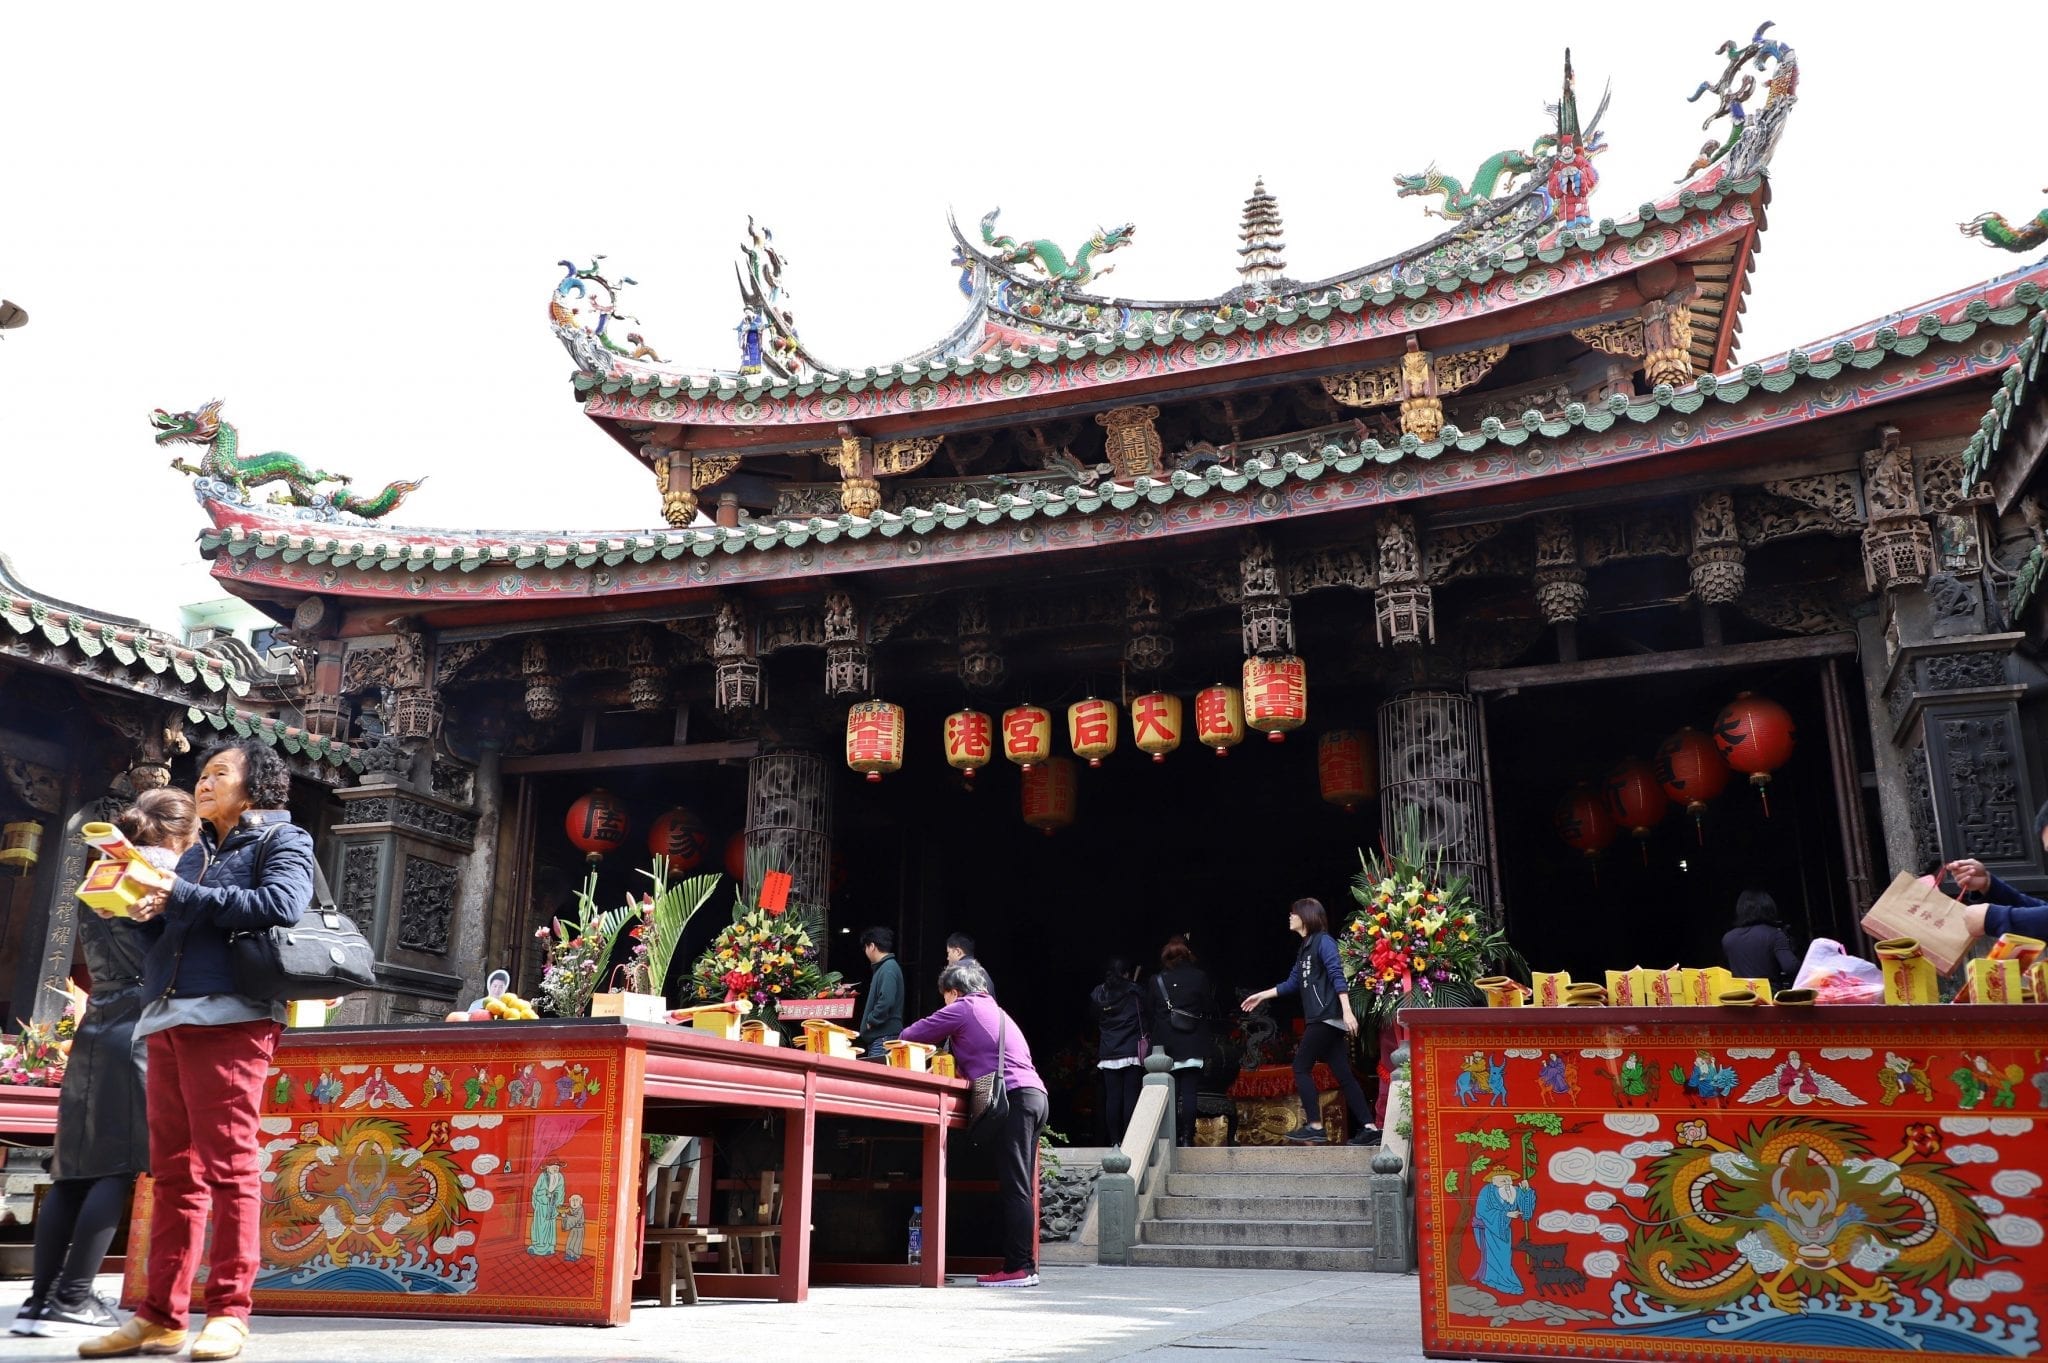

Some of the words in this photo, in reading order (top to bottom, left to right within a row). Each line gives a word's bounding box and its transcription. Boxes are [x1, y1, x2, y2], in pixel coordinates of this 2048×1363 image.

[948, 714, 991, 757] 港
[1004, 708, 1046, 754] 宮
[1074, 701, 1109, 748] 后
[1136, 696, 1175, 742] 天
